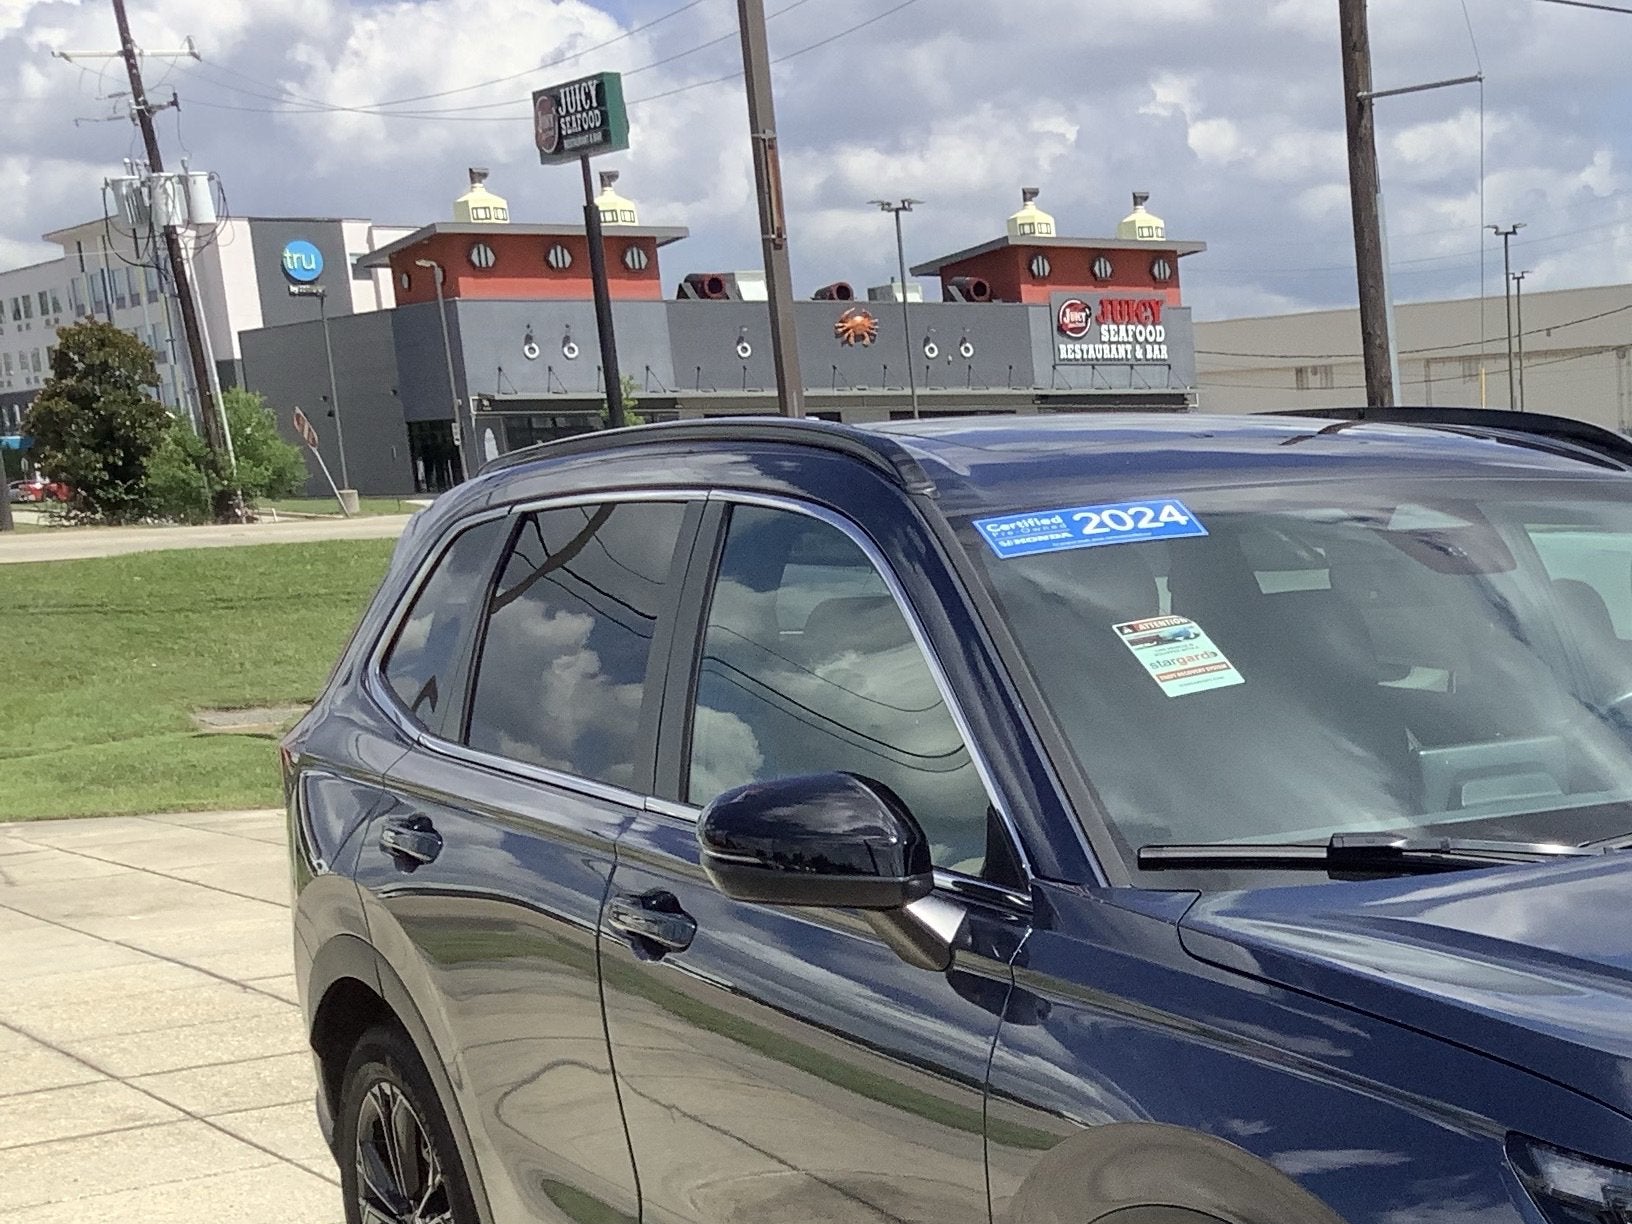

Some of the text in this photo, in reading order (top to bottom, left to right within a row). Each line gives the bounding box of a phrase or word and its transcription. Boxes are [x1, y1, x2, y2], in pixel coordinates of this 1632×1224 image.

[559, 80, 599, 115] JUICY
[560, 109, 601, 135] SEAFOOD
[283, 248, 316, 269] tru
[1095, 300, 1163, 325] JUICY
[1101, 324, 1166, 342] SEAFOOD
[1059, 344, 1168, 359] RESTAURANT & BAR
[986, 505, 1189, 535] Certified 2024
[1139, 618, 1189, 631] ATTENTION
